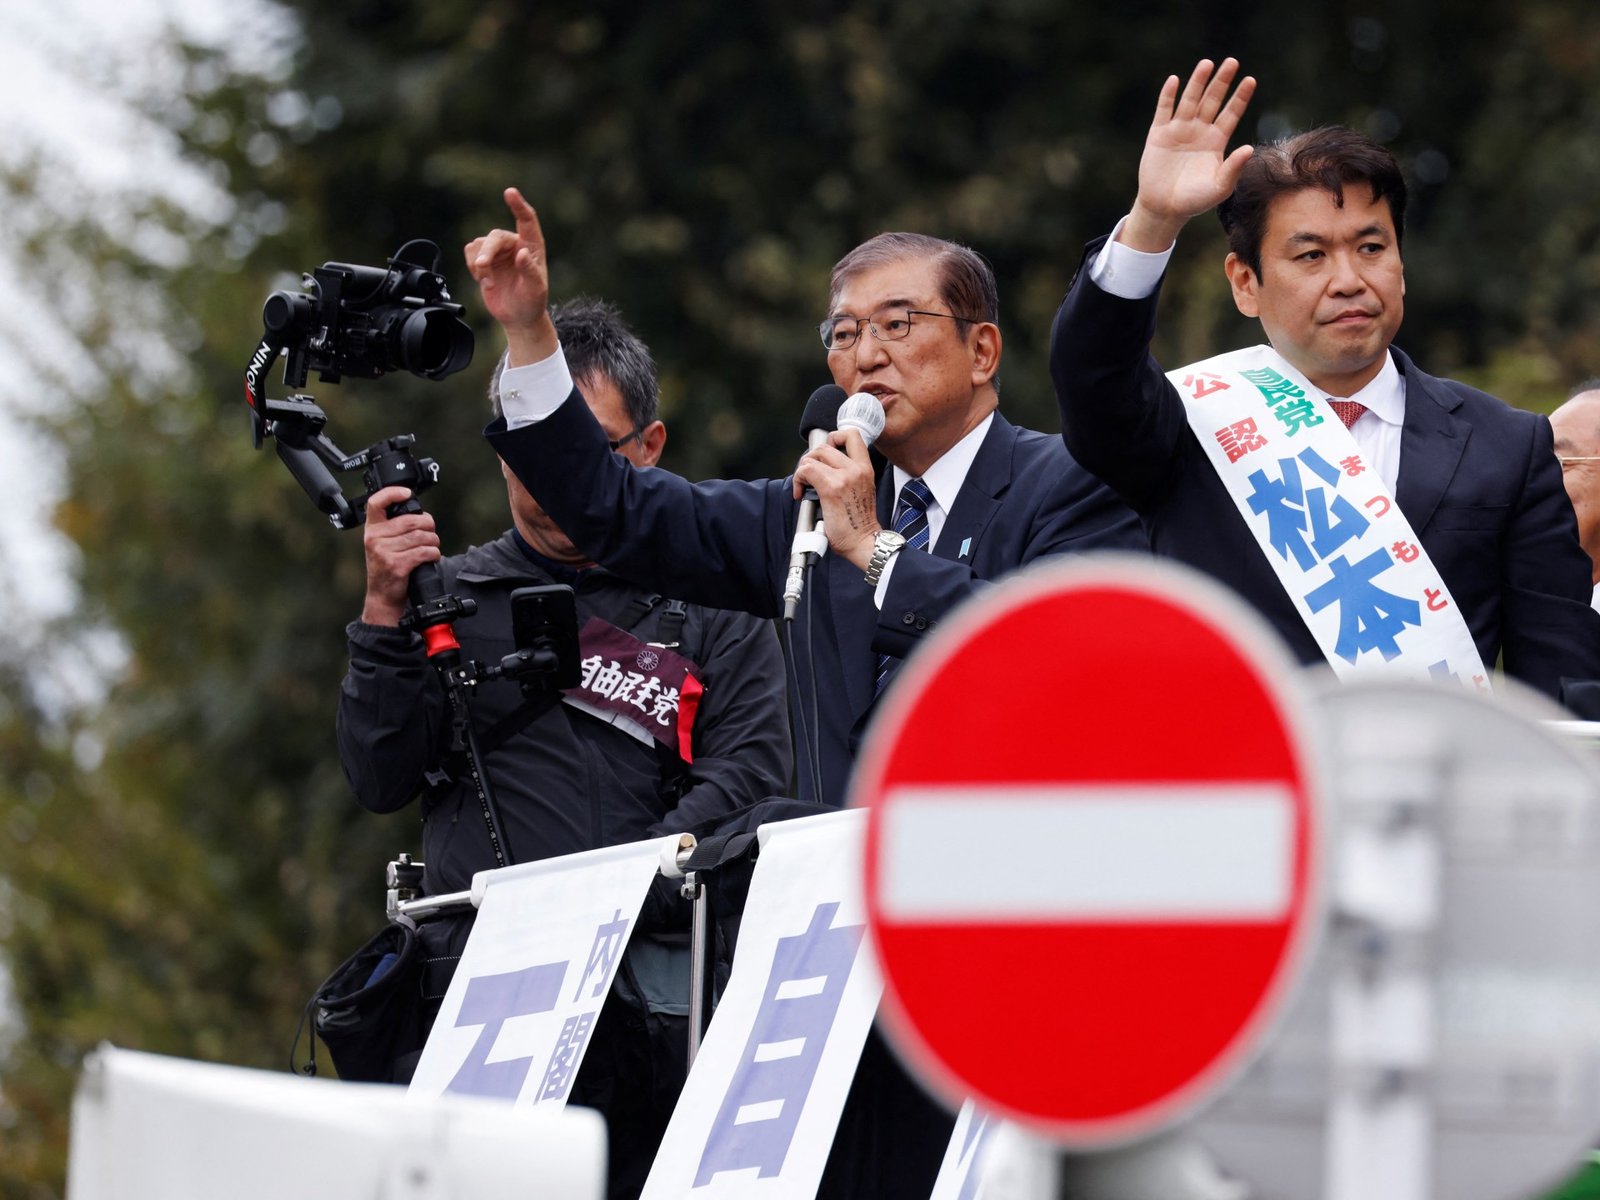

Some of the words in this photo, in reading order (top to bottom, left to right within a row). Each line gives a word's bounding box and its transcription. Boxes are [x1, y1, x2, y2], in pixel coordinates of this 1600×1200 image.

[246, 341, 271, 396] RONIN
[1182, 372, 1268, 464] 公認
[1246, 446, 1463, 688] 松本
[581, 655, 680, 726] 自由民主党
[533, 908, 630, 1105] 内閣
